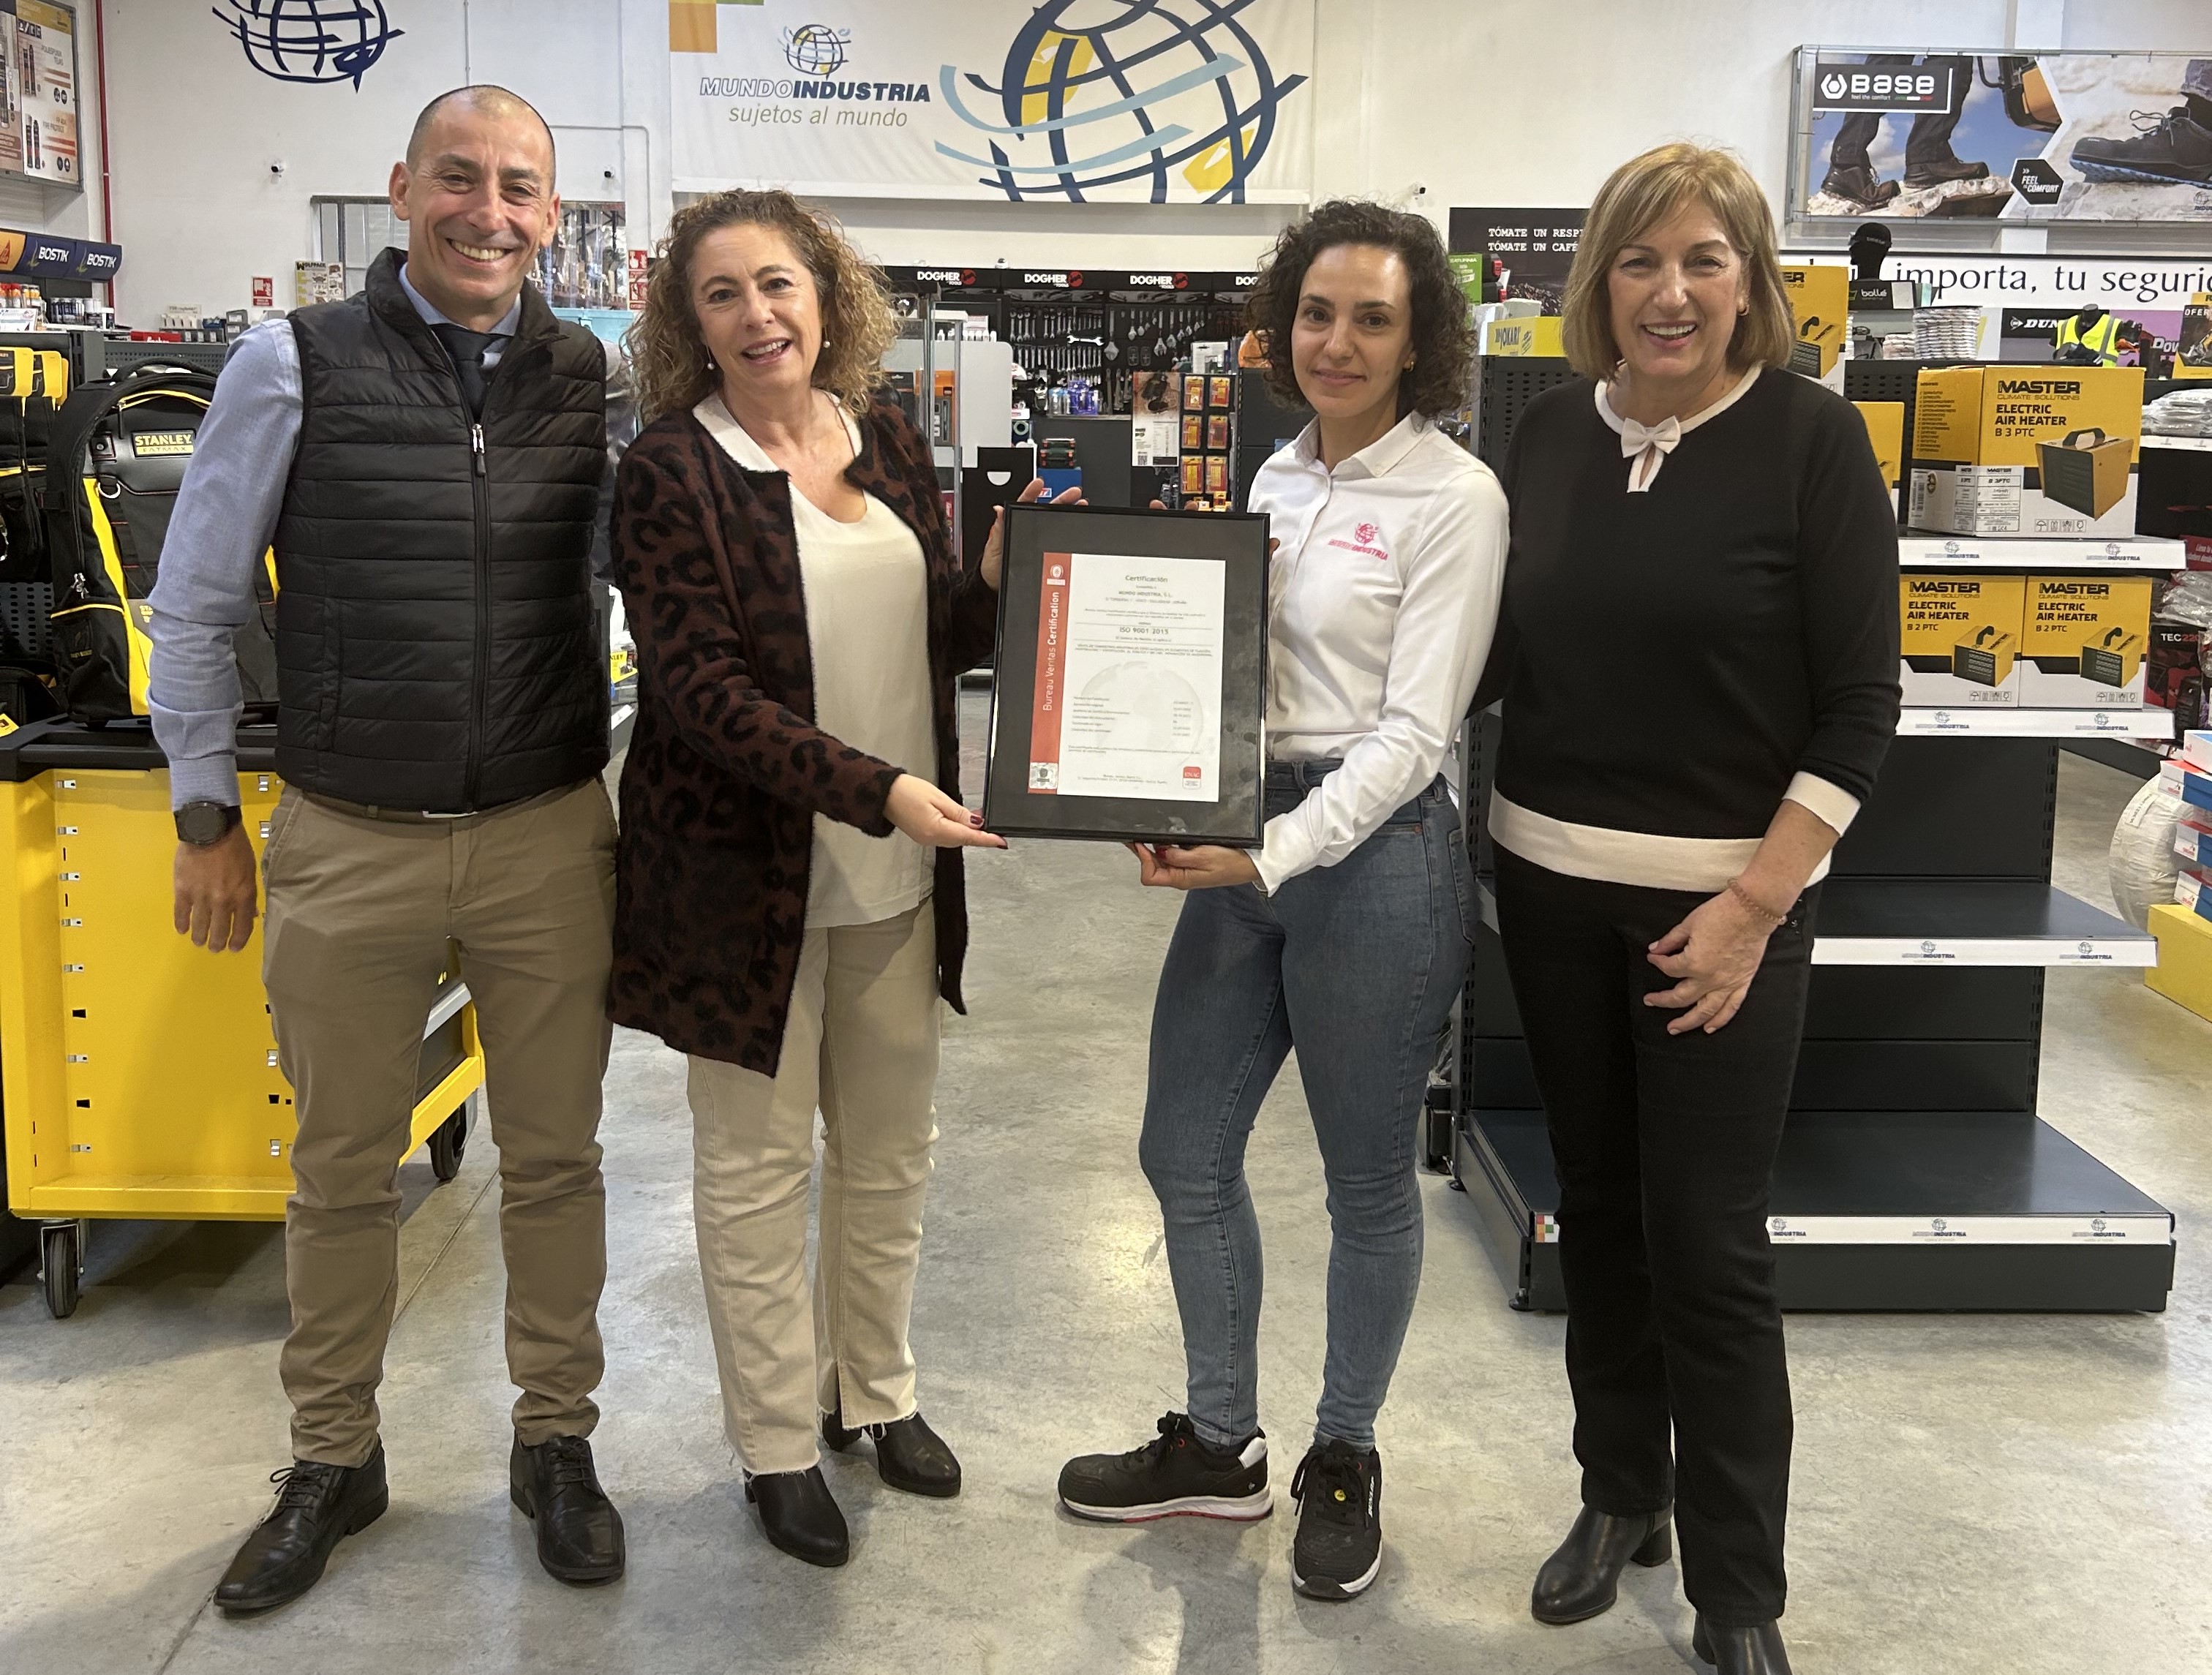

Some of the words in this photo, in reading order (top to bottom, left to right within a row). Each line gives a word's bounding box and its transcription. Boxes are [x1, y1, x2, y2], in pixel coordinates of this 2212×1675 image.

[699, 77, 931, 102] MUNDOINDUSTRIA
[728, 104, 802, 127] sujetos
[809, 106, 829, 125] al
[835, 108, 908, 127] mundo
[2021, 175, 2039, 185] FEEL
[2027, 184, 2059, 193] COMFORT
[1488, 226, 1528, 237] TÓMATE
[1533, 228, 1547, 238] UN
[1487, 240, 1527, 252] TÓMATE
[1532, 243, 1546, 252] UN
[1551, 240, 1579, 252] CAFÉ
[38, 246, 70, 263] BOSTIK
[86, 253, 117, 268] BOSTIK
[917, 271, 960, 281] DOGHER
[1024, 274, 1067, 283] DOGHER
[1129, 275, 1173, 285] DOGHER
[2054, 266, 2086, 291] tu
[1860, 288, 1887, 297] bollé
[1998, 380, 2080, 394] MASTER
[1996, 404, 2052, 414] ELECTRIC
[1995, 415, 2016, 425] AIR
[2019, 415, 2067, 426] HEATER
[1995, 428, 2003, 437] B
[2005, 428, 2012, 437] 3
[2014, 428, 2035, 437] PTC
[135, 434, 192, 445] STANLEY
[1909, 581, 1980, 593] MASTER
[2039, 583, 2110, 595] MASTER
[1908, 601, 1957, 610] ELECTRIC
[2038, 603, 2085, 611] ELECTRIC
[1047, 591, 1060, 645] Certification
[1907, 611, 1925, 620] AIR
[1928, 611, 1969, 620] HEATER
[2036, 613, 2055, 621] AIR
[2057, 613, 2098, 622] HEATER
[1045, 647, 1056, 677] Veritas
[1042, 679, 1054, 712] Bureau
